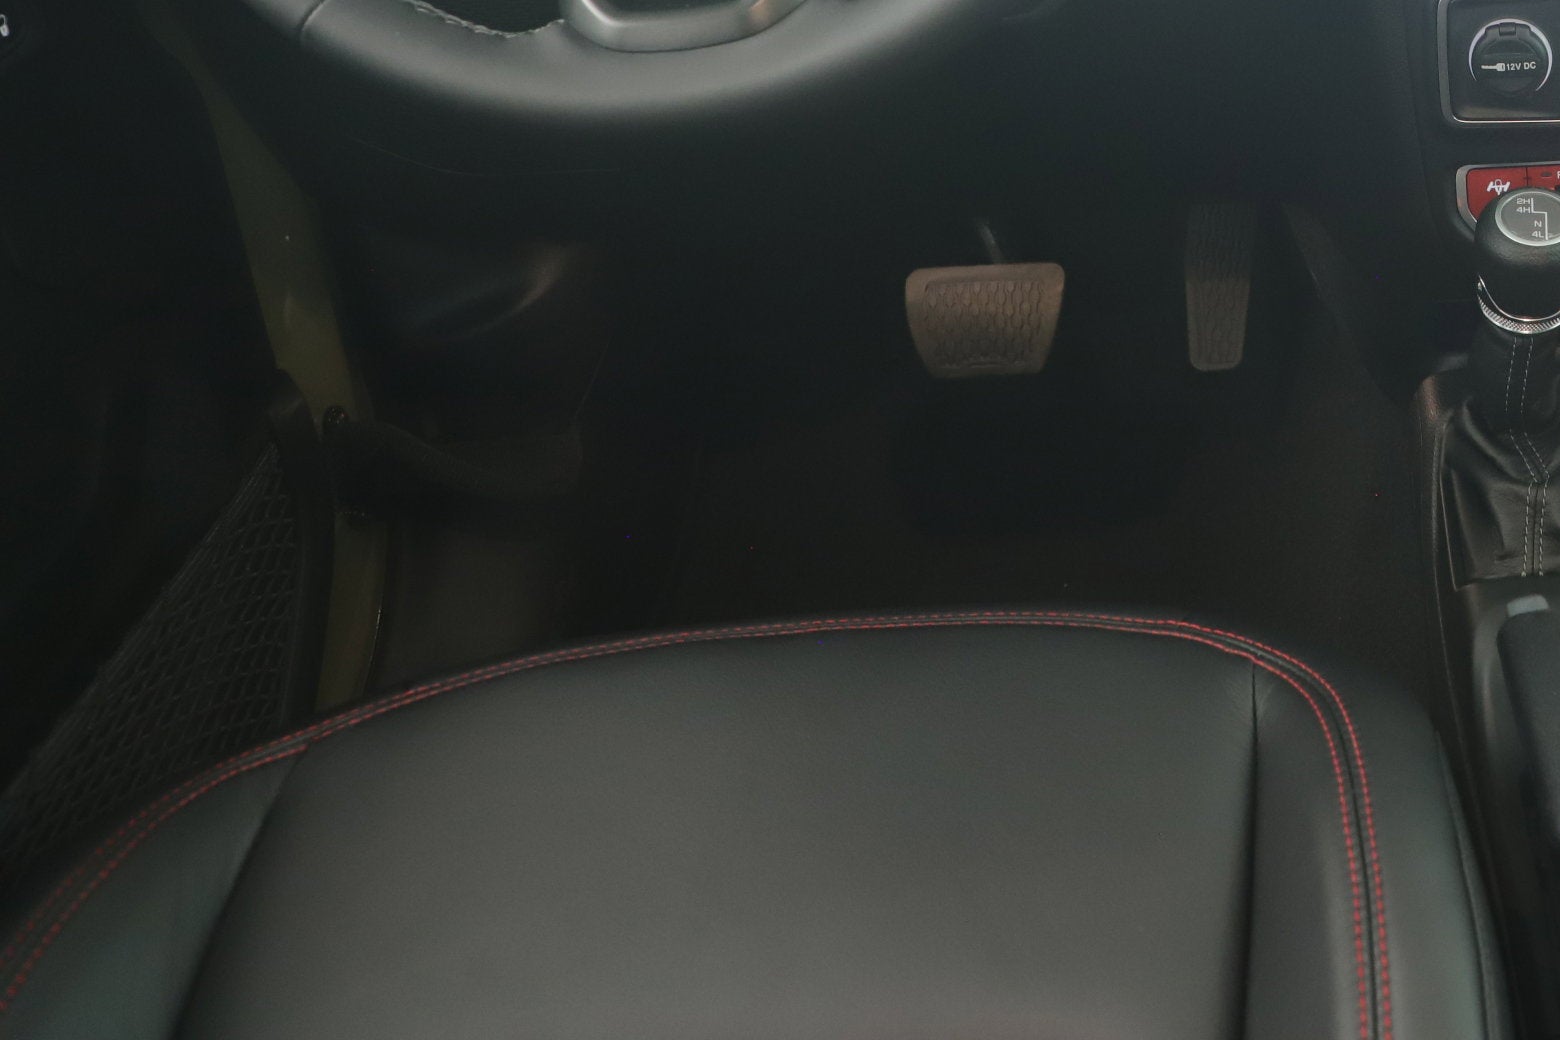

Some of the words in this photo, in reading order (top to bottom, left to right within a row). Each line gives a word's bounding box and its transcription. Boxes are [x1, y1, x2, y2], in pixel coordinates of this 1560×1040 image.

[1506, 62, 1521, 71] 12V
[1523, 61, 1537, 70] DC
[1533, 220, 1542, 228] N
